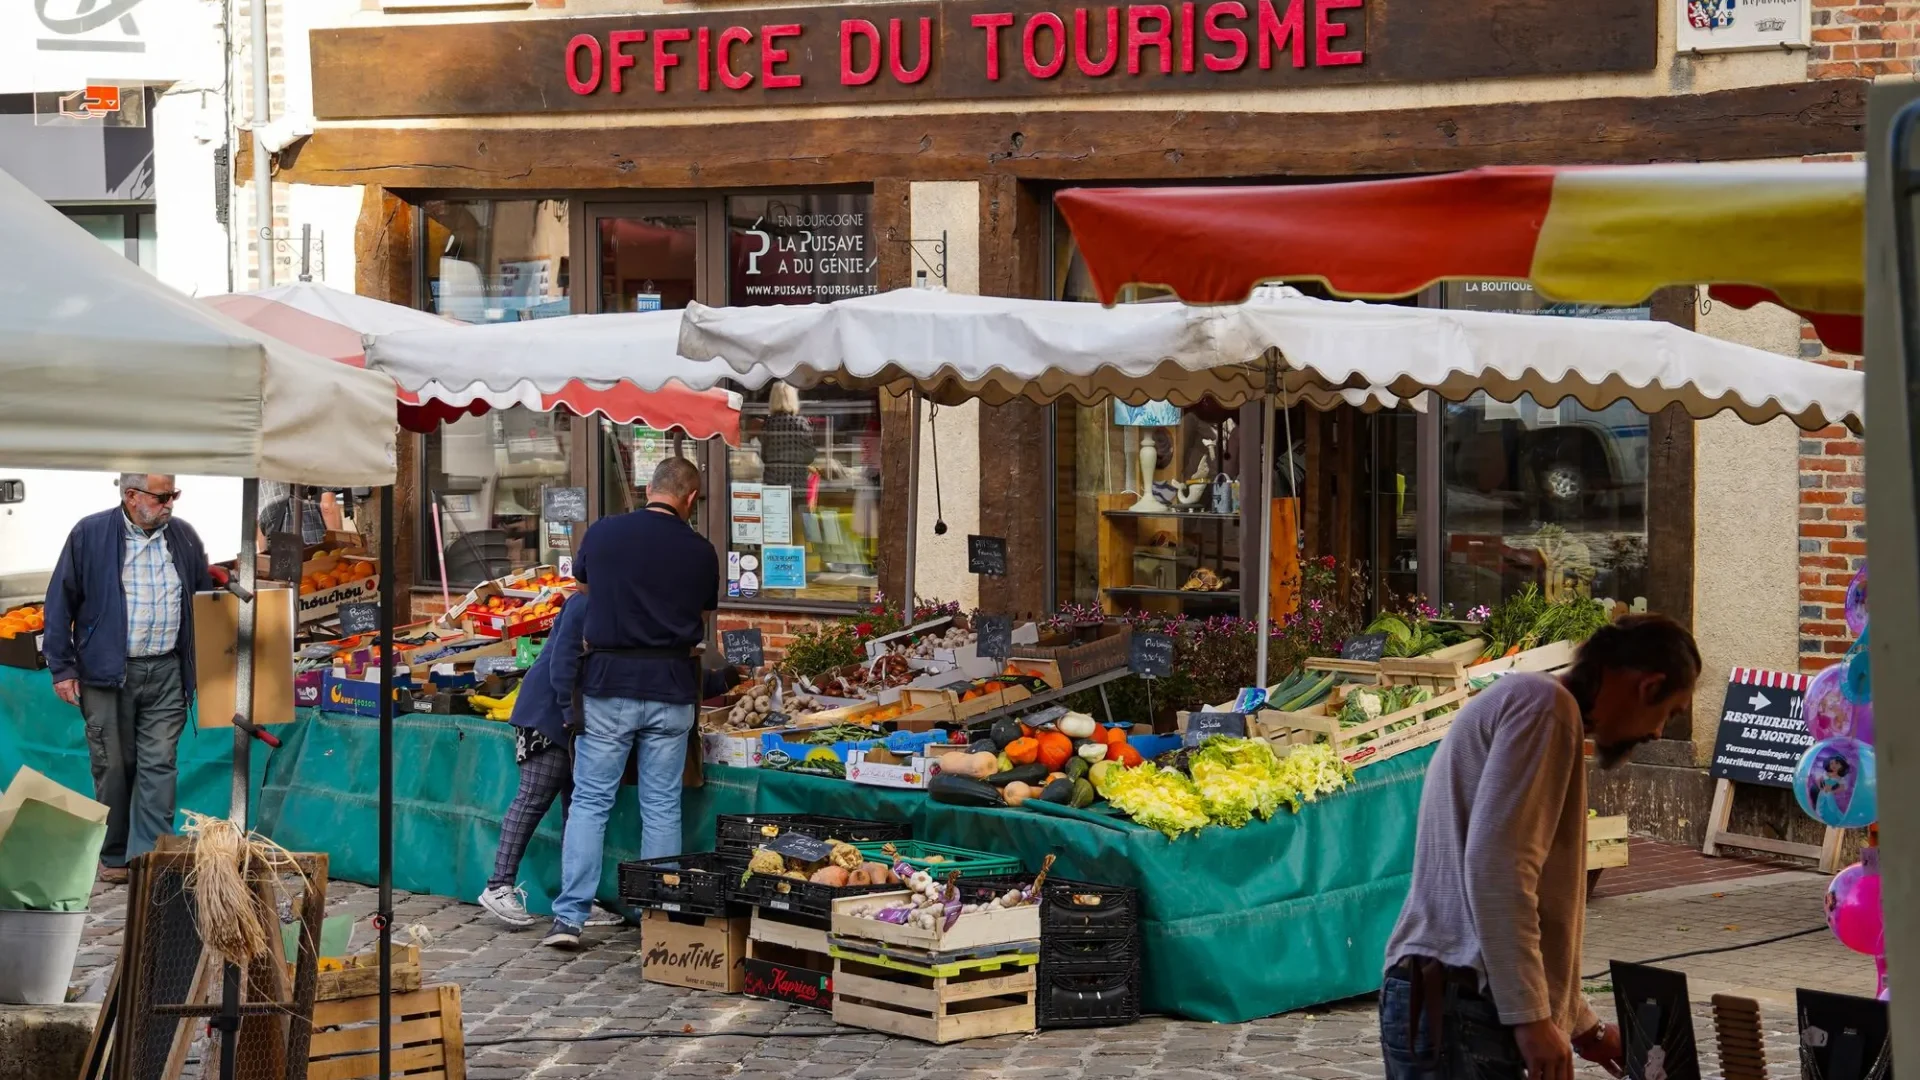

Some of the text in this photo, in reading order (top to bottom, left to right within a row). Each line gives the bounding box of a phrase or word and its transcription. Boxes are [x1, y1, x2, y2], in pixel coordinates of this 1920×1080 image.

[565, 0, 1363, 95] OFFICE DU TOURISME
[778, 214, 863, 227] EN BOURGOGNE
[778, 230, 863, 252] LA PUISAYE
[778, 259, 788, 274] A
[793, 258, 813, 274] DU
[1465, 282, 1533, 292] LA BOUTIQUE
[1724, 711, 1809, 732] RESTAURANT/
[1741, 727, 1816, 746] LE MONTECR
[1725, 744, 1756, 755] Terrasse
[1756, 748, 1789, 760] ombragée
[1716, 755, 1795, 773] Distributeur automa
[768, 967, 818, 999] Kaprices
